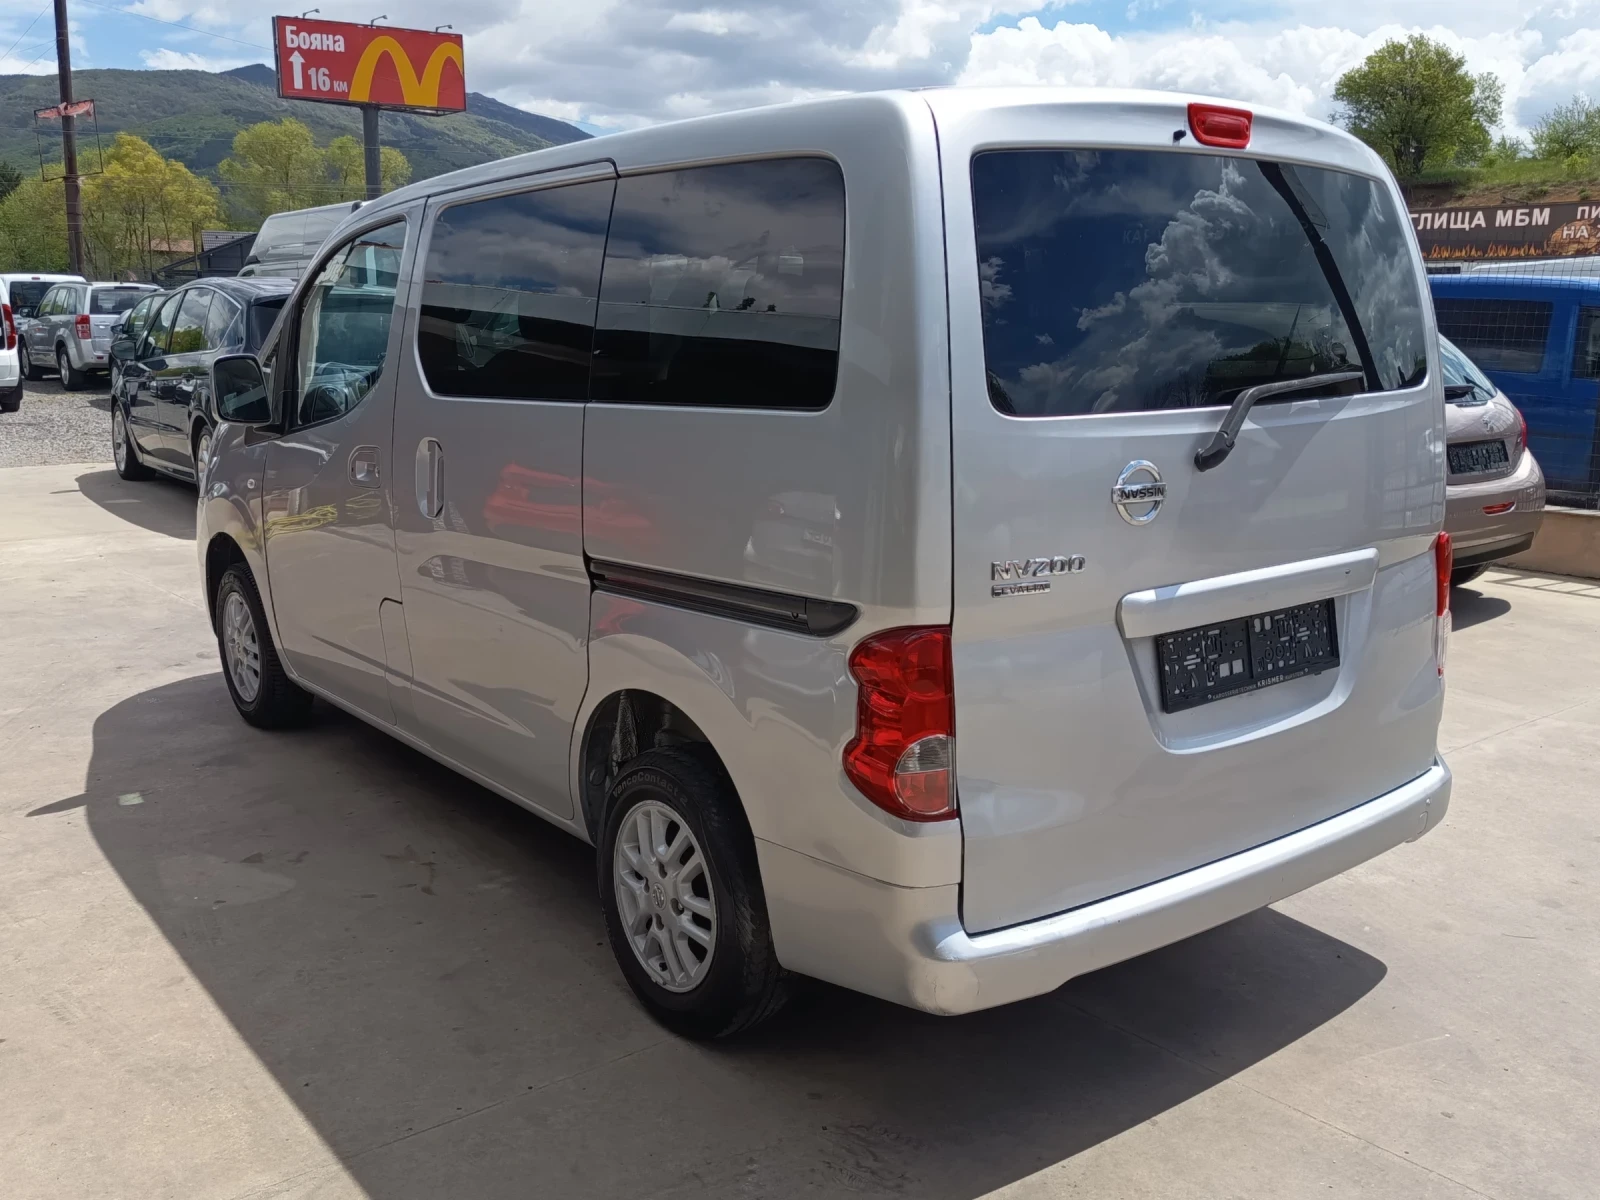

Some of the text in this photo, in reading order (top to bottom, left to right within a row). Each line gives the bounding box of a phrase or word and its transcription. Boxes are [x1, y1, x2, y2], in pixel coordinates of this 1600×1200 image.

[286, 25, 345, 53] Бояна
[308, 67, 331, 91] 16
[1495, 208, 1550, 227] МБМ
[1562, 225, 1589, 239] НА
[991, 554, 1086, 580] NV200
[1257, 675, 1284, 688] KRISMER
[612, 771, 679, 798] VancoContact
